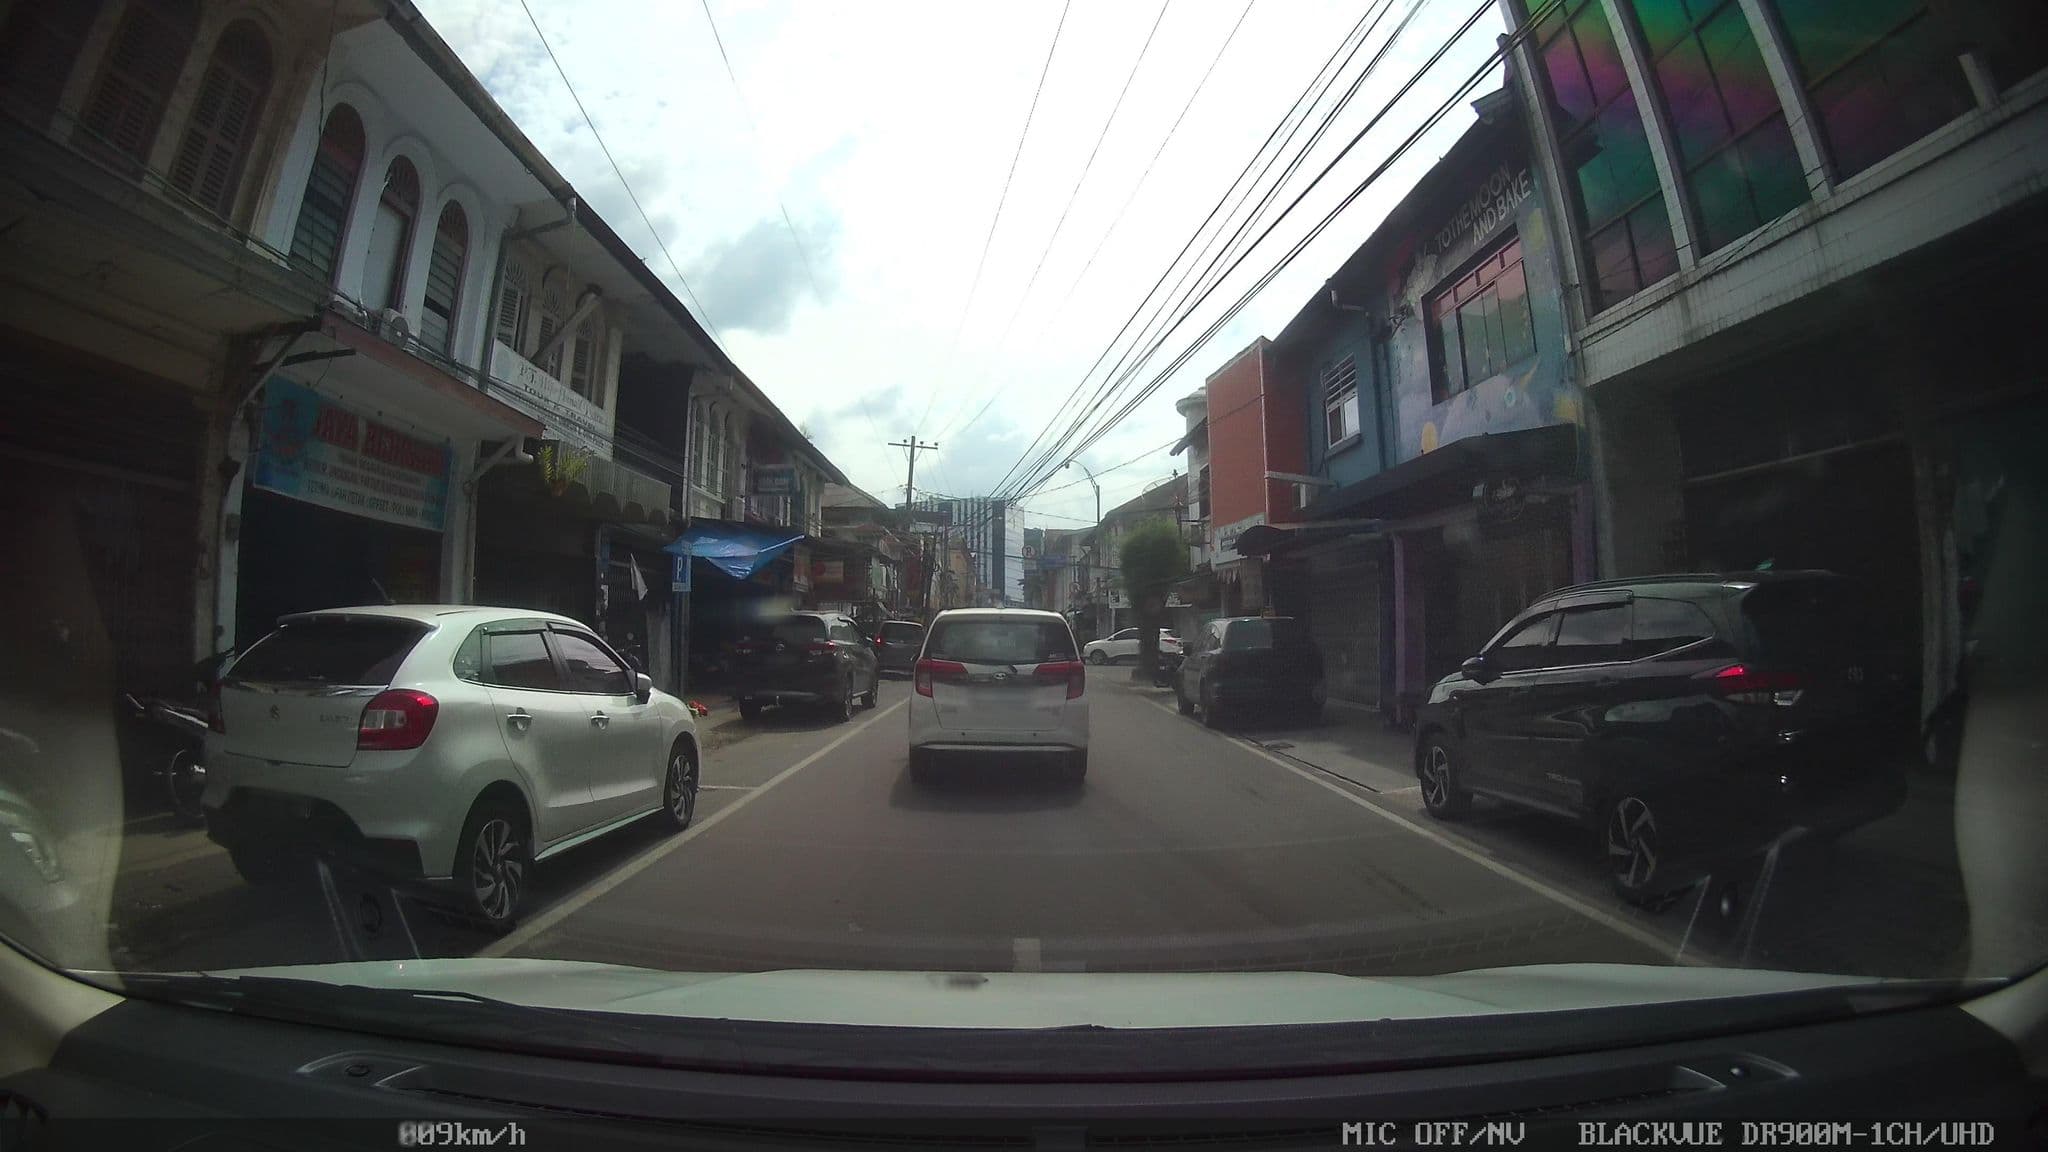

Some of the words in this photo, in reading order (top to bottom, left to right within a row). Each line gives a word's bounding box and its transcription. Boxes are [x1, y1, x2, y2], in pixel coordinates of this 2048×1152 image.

[1469, 162, 1512, 220] MOON
[1472, 207, 1497, 245] AND
[1496, 168, 1532, 221] BAKE
[676, 556, 684, 581] P
